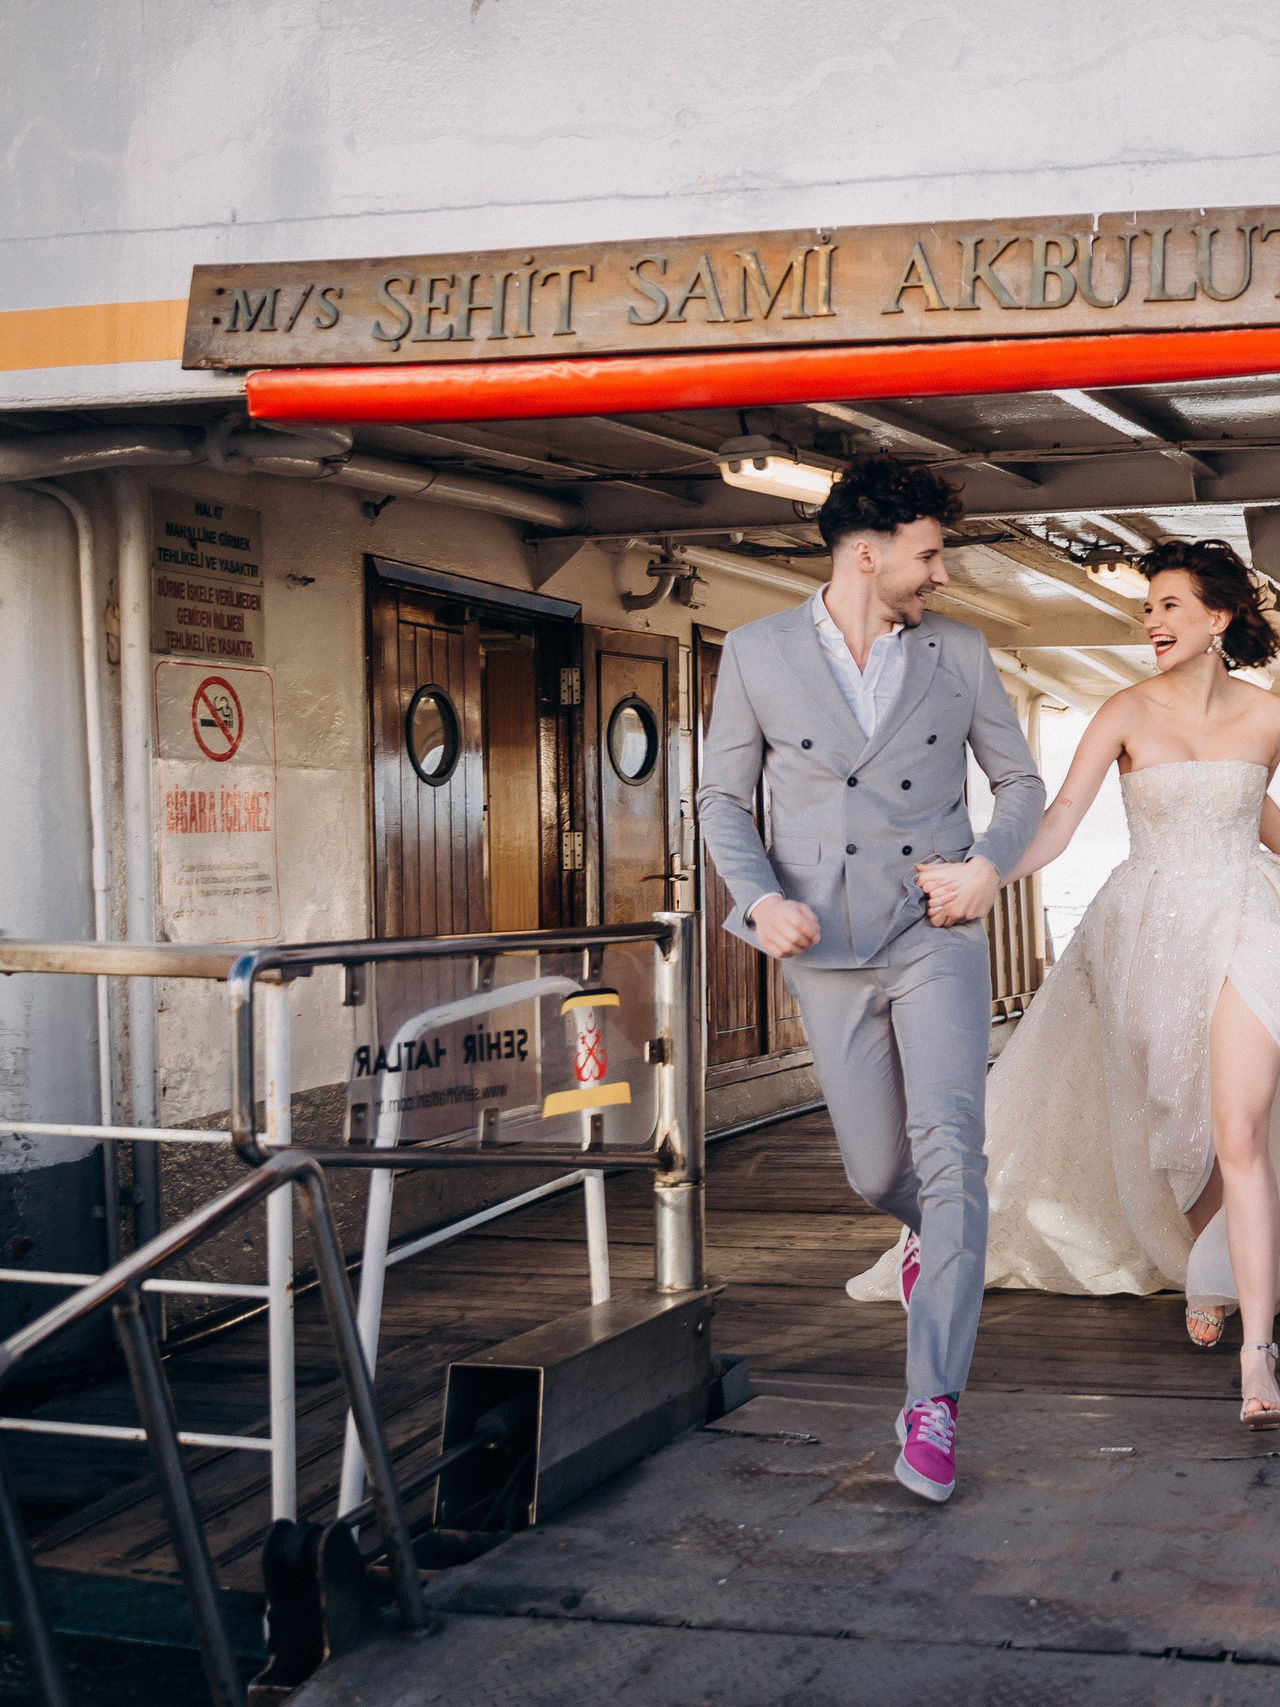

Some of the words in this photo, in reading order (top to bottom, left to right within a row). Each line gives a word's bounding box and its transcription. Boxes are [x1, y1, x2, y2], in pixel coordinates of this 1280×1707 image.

[225, 284, 344, 333] M/S
[372, 254, 594, 352] ŞEHİT
[628, 233, 837, 326] SAMİ
[205, 556, 217, 571] VE
[219, 558, 259, 578] YASAKTIR
[206, 635, 216, 654] VE
[165, 784, 217, 834] SİGARA
[220, 784, 271, 839] İÇİLMEZ
